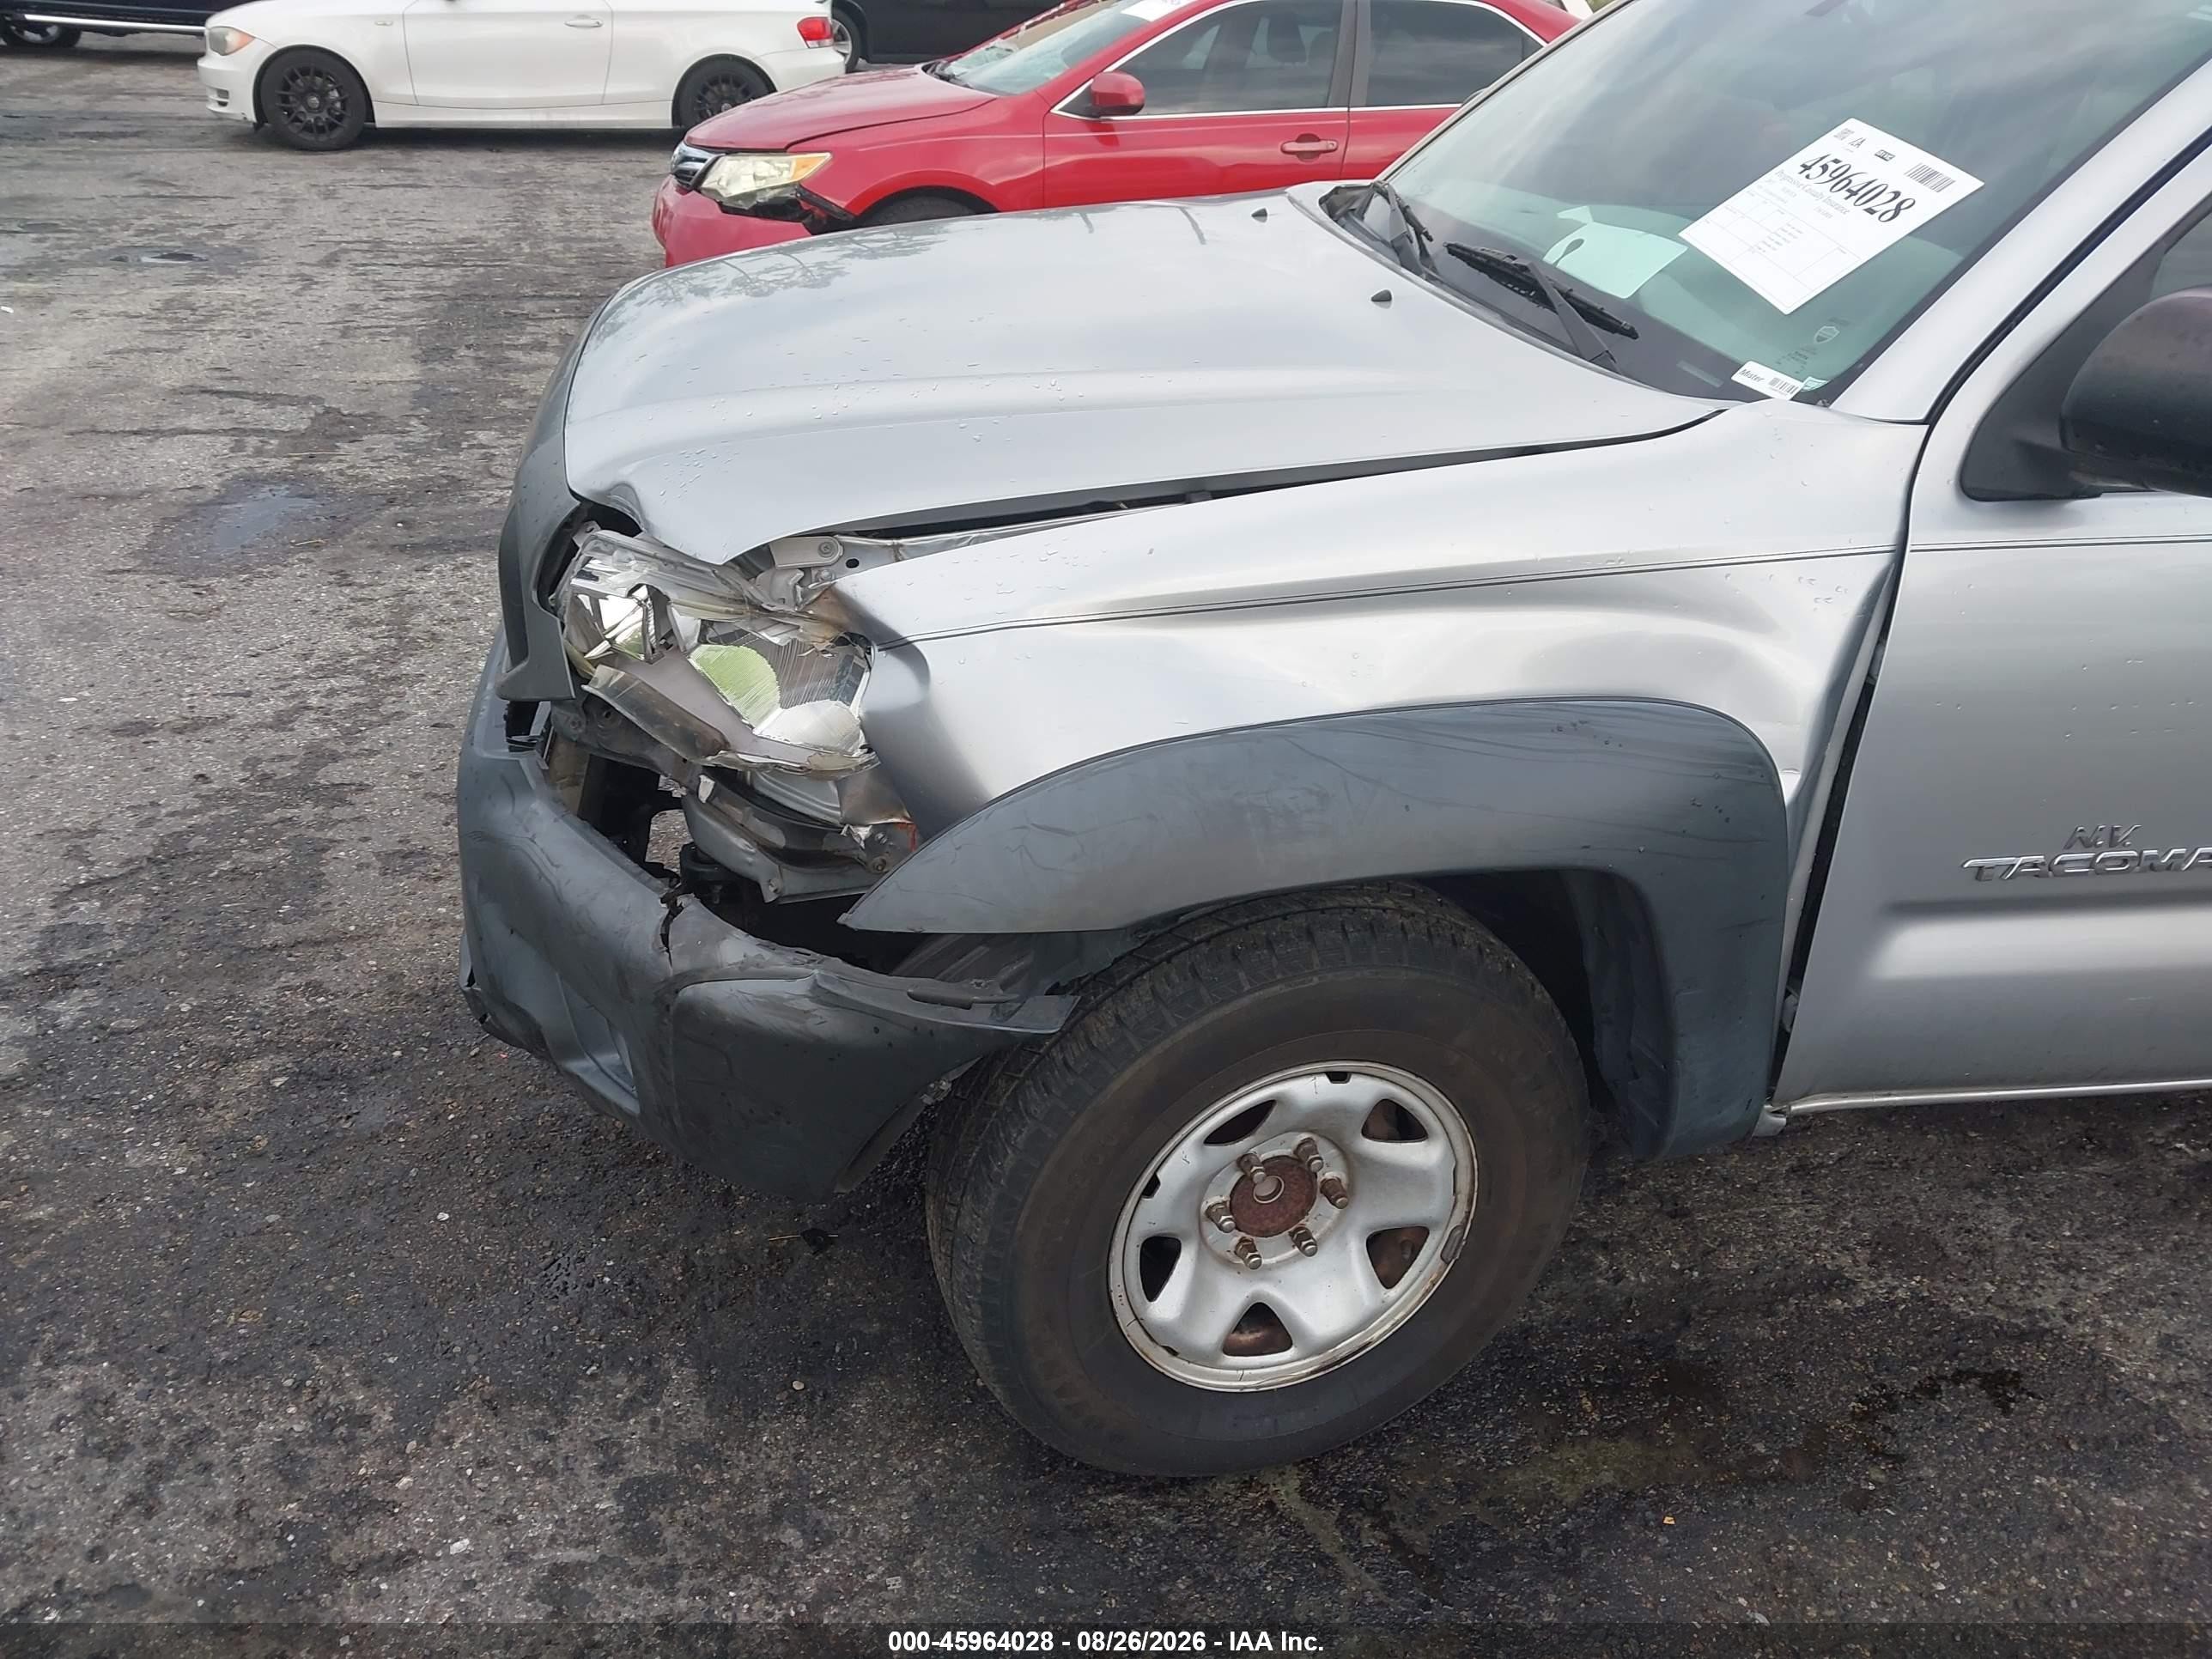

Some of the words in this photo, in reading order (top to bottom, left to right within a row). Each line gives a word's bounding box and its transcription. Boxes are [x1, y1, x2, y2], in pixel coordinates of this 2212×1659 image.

[1797, 153, 1917, 223] 45964028
[1739, 368, 1765, 383] Mister
[1962, 847, 2212, 882] TACOMA
